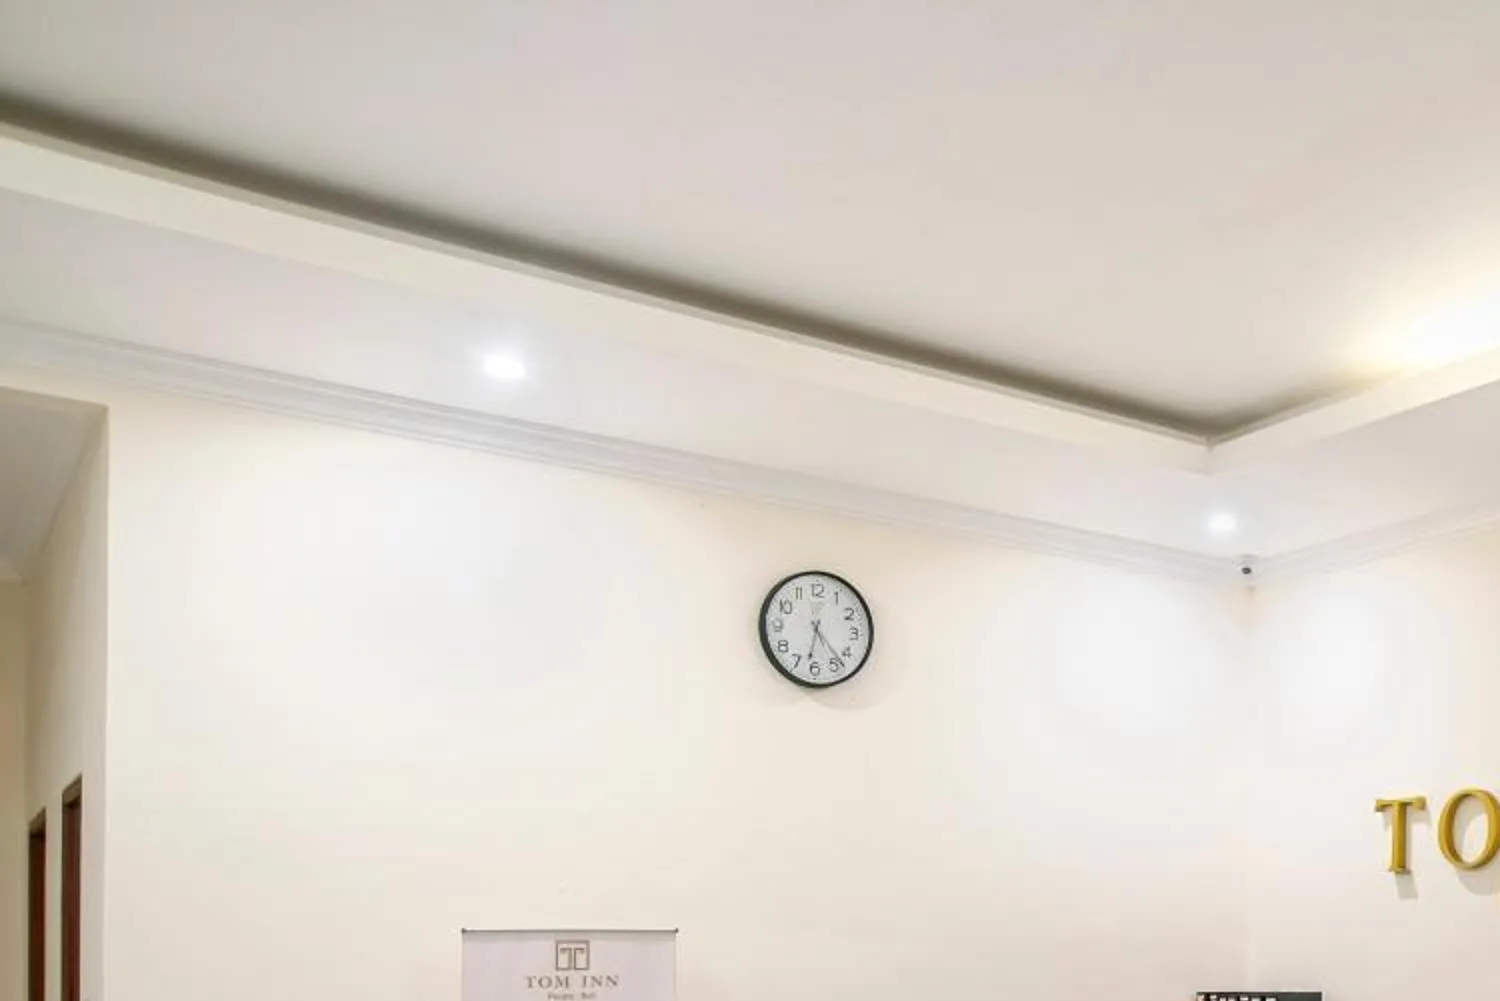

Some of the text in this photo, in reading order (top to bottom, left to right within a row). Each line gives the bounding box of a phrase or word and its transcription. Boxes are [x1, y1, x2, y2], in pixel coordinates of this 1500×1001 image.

[795, 586, 803, 601] 11
[811, 583, 825, 598] 12
[834, 591, 840, 605] 1
[779, 600, 793, 615] 10
[844, 607, 855, 621] 2
[849, 627, 859, 641] 3
[777, 639, 789, 653] 8
[841, 646, 852, 658] 4
[791, 653, 802, 668] 7
[828, 657, 839, 673] 5
[809, 661, 821, 676] 6
[526, 974, 620, 990] TOM INN
